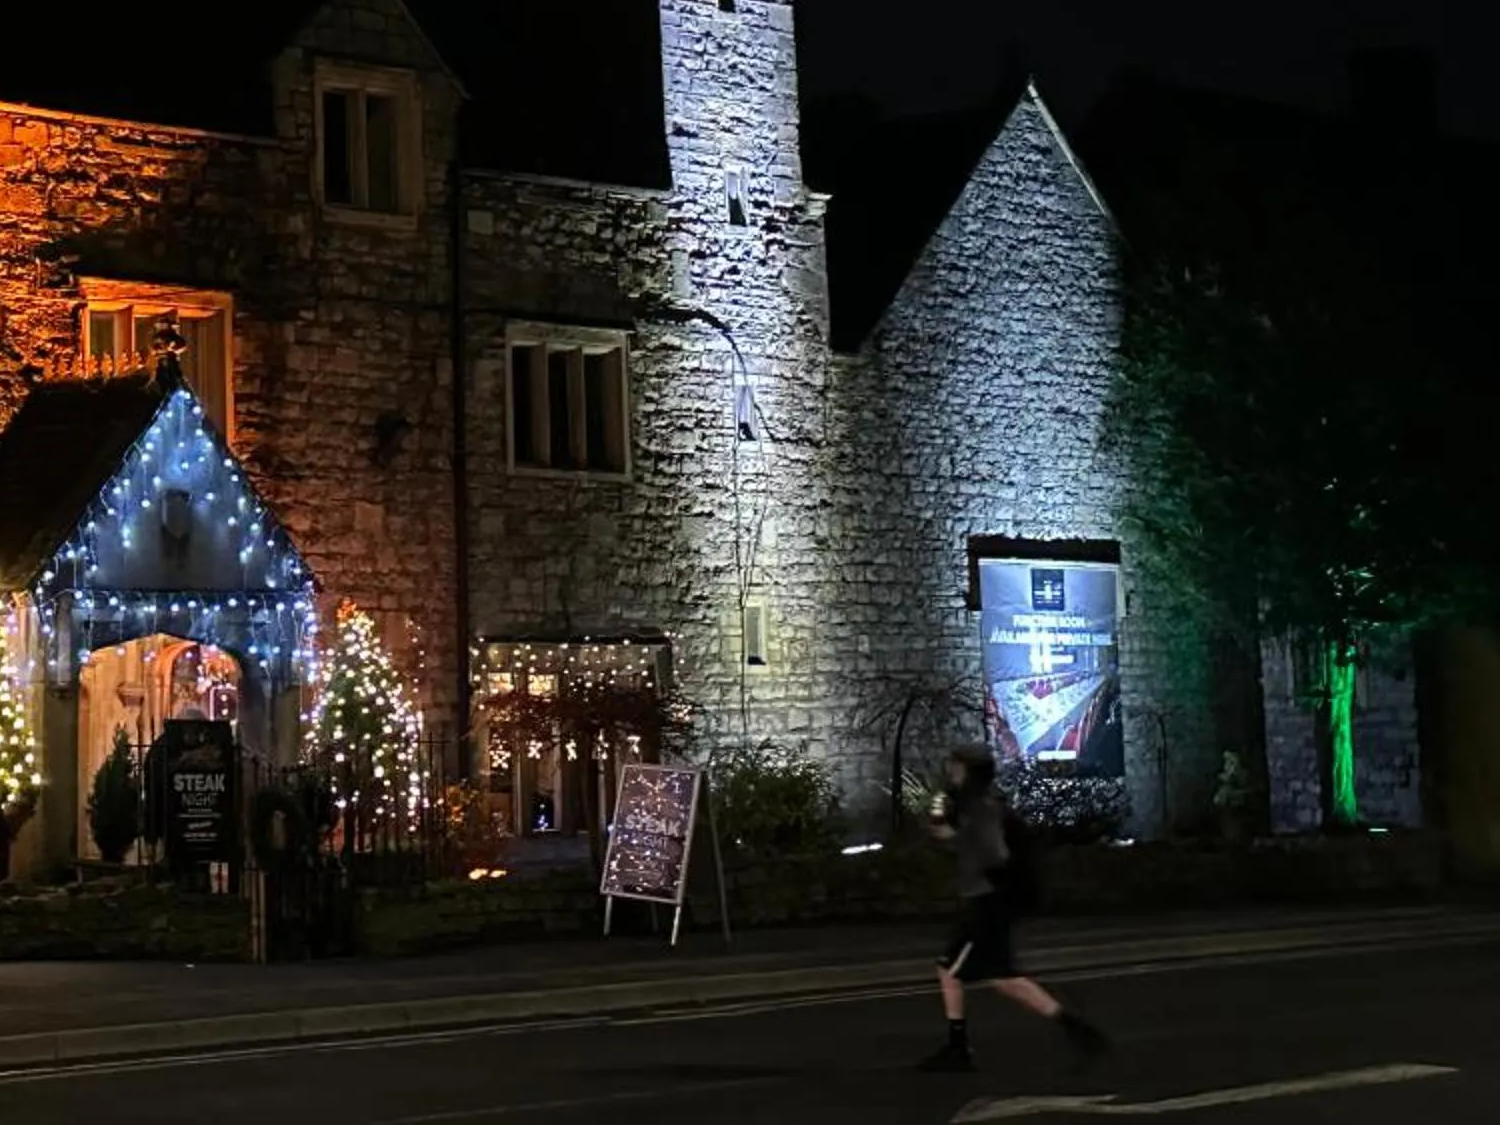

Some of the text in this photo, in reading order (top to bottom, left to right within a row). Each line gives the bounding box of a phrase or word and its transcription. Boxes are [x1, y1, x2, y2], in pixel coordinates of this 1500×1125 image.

[173, 772, 226, 793] STEAK
[181, 792, 218, 806] NIGHT
[625, 813, 681, 837] STEAK
